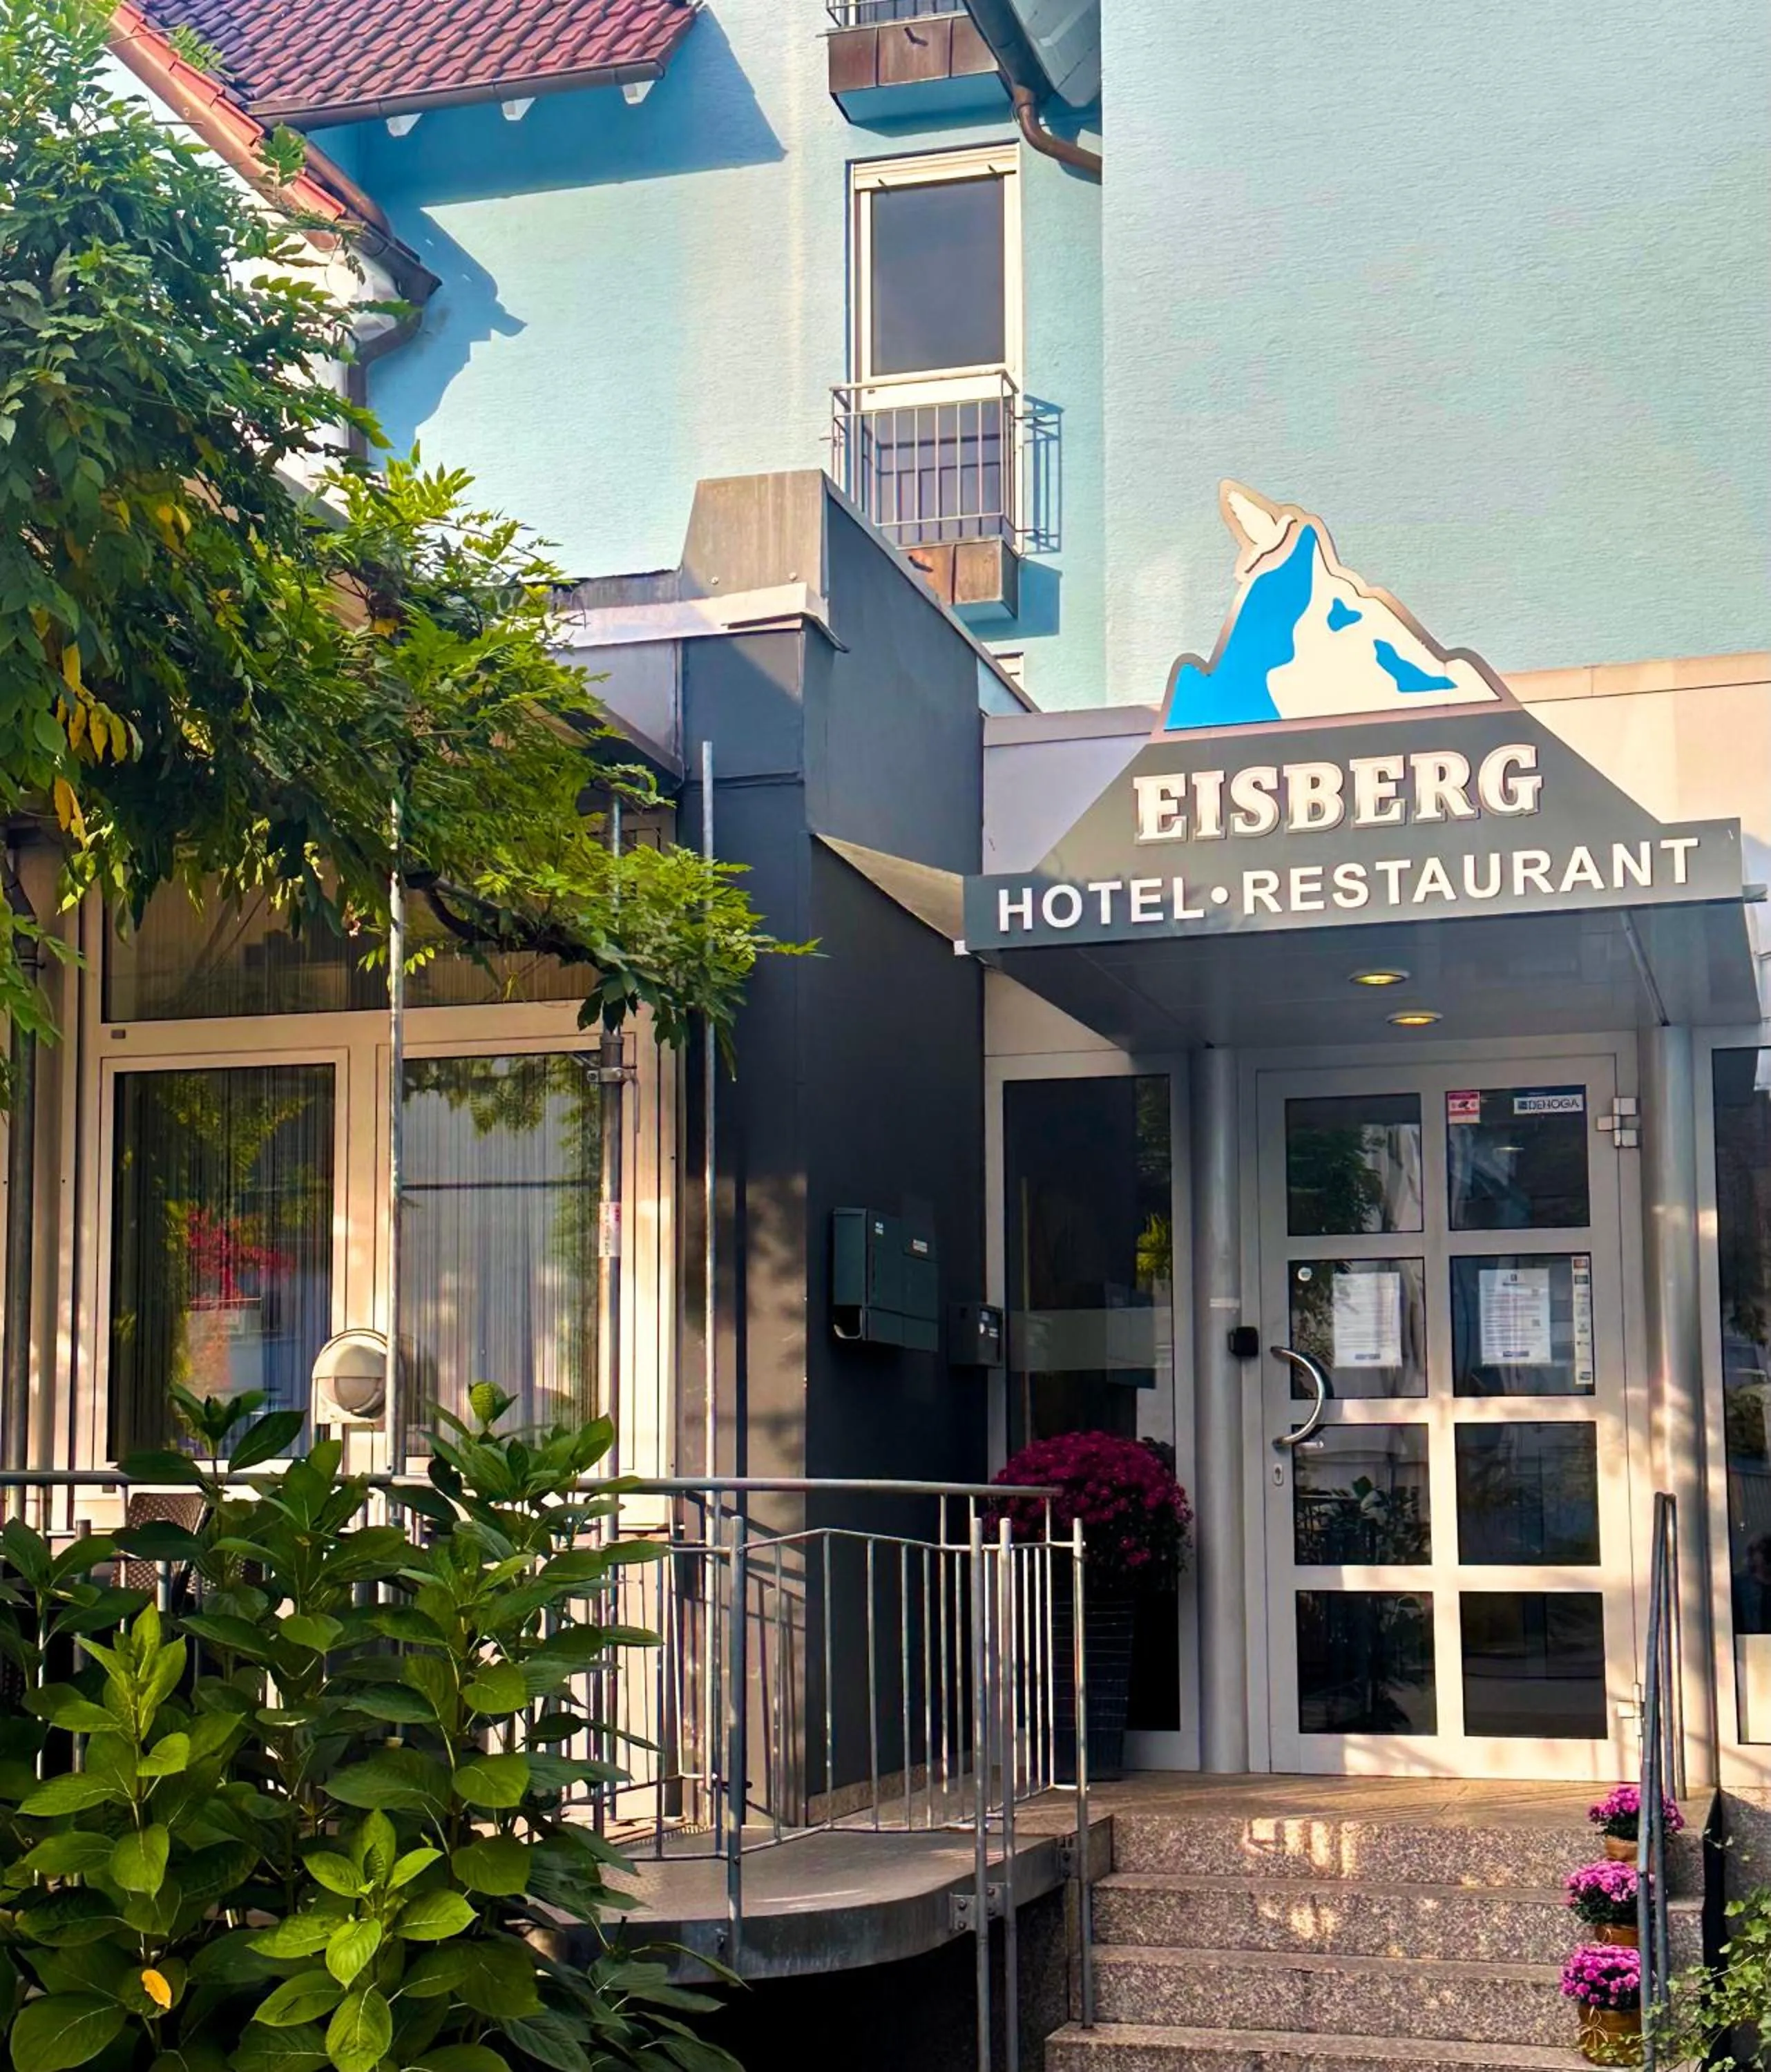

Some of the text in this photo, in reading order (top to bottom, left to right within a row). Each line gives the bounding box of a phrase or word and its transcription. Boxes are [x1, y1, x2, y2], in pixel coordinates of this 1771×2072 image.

[1133, 744, 1542, 845] EISBERG
[999, 838, 1699, 932] HOTEL RESTAURANT
[1527, 1098, 1580, 1111] DEHOGA
